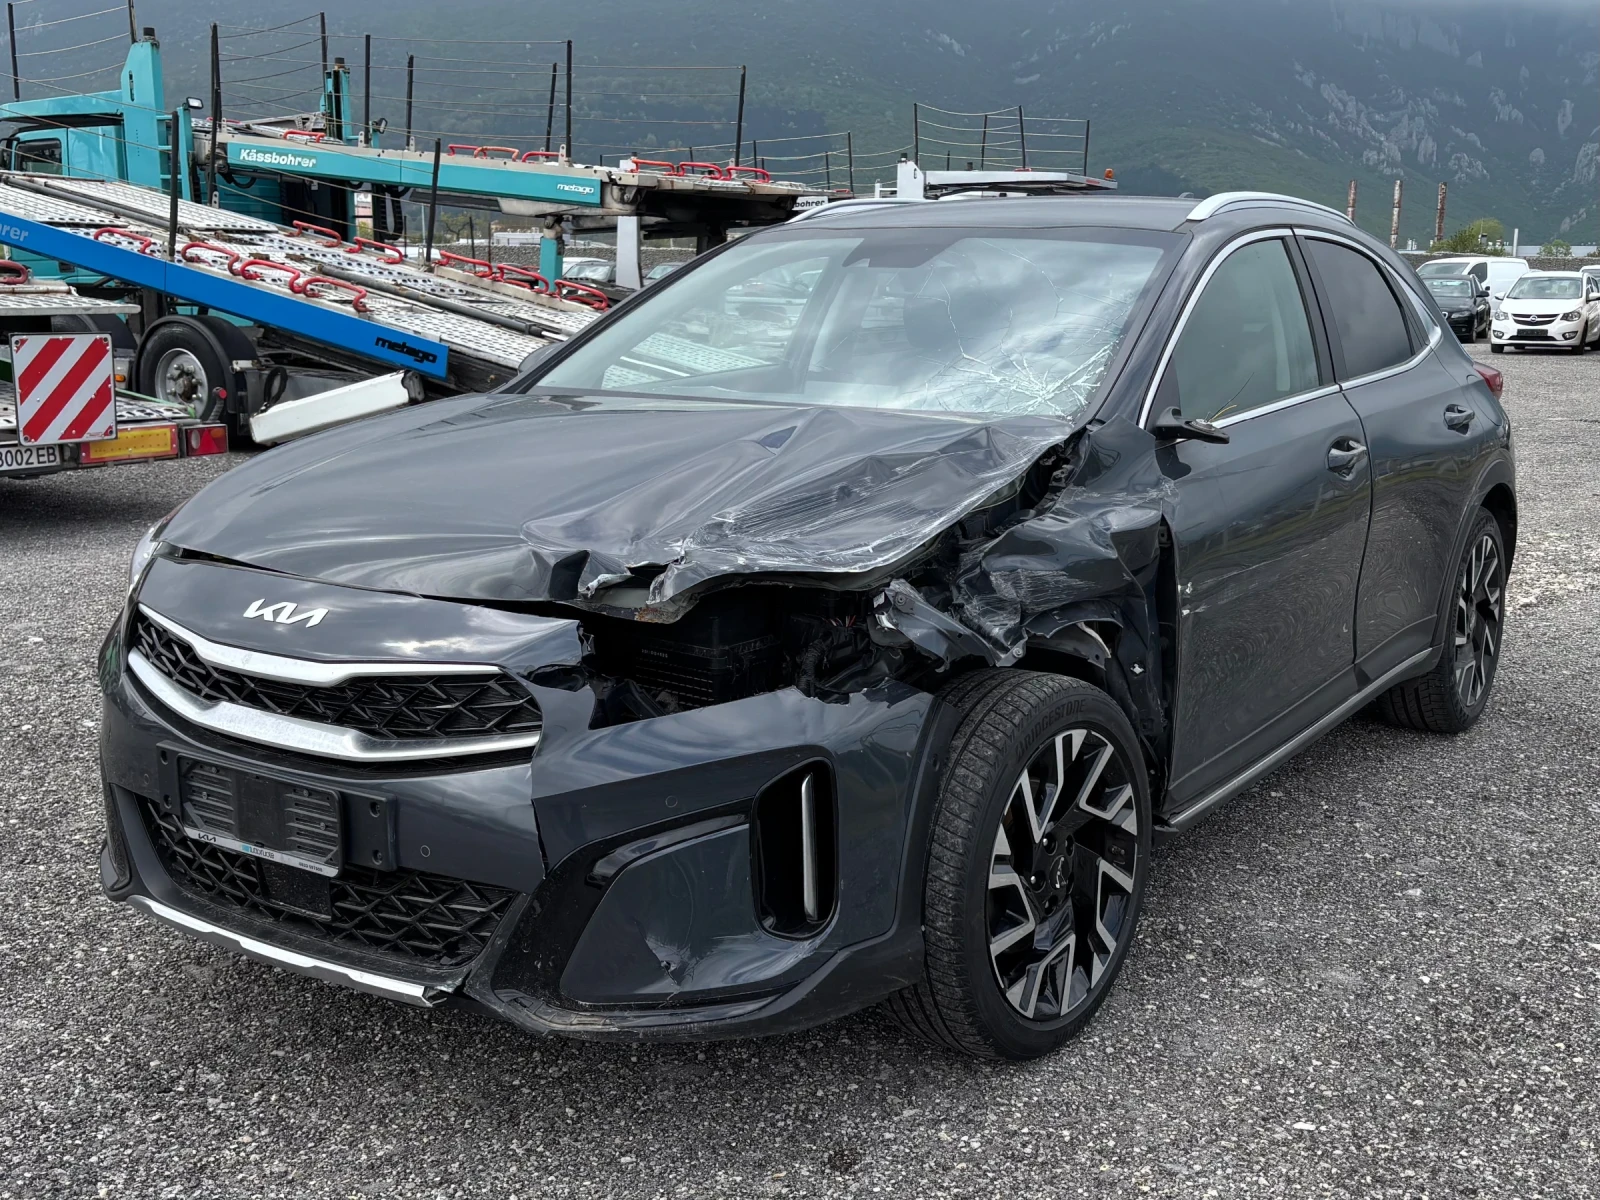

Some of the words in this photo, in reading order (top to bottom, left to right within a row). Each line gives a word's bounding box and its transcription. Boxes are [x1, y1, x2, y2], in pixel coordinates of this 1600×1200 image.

[240, 149, 317, 168] Kässbohrer
[557, 183, 594, 195] metago
[0, 223, 29, 242] rer
[375, 337, 437, 363] metago
